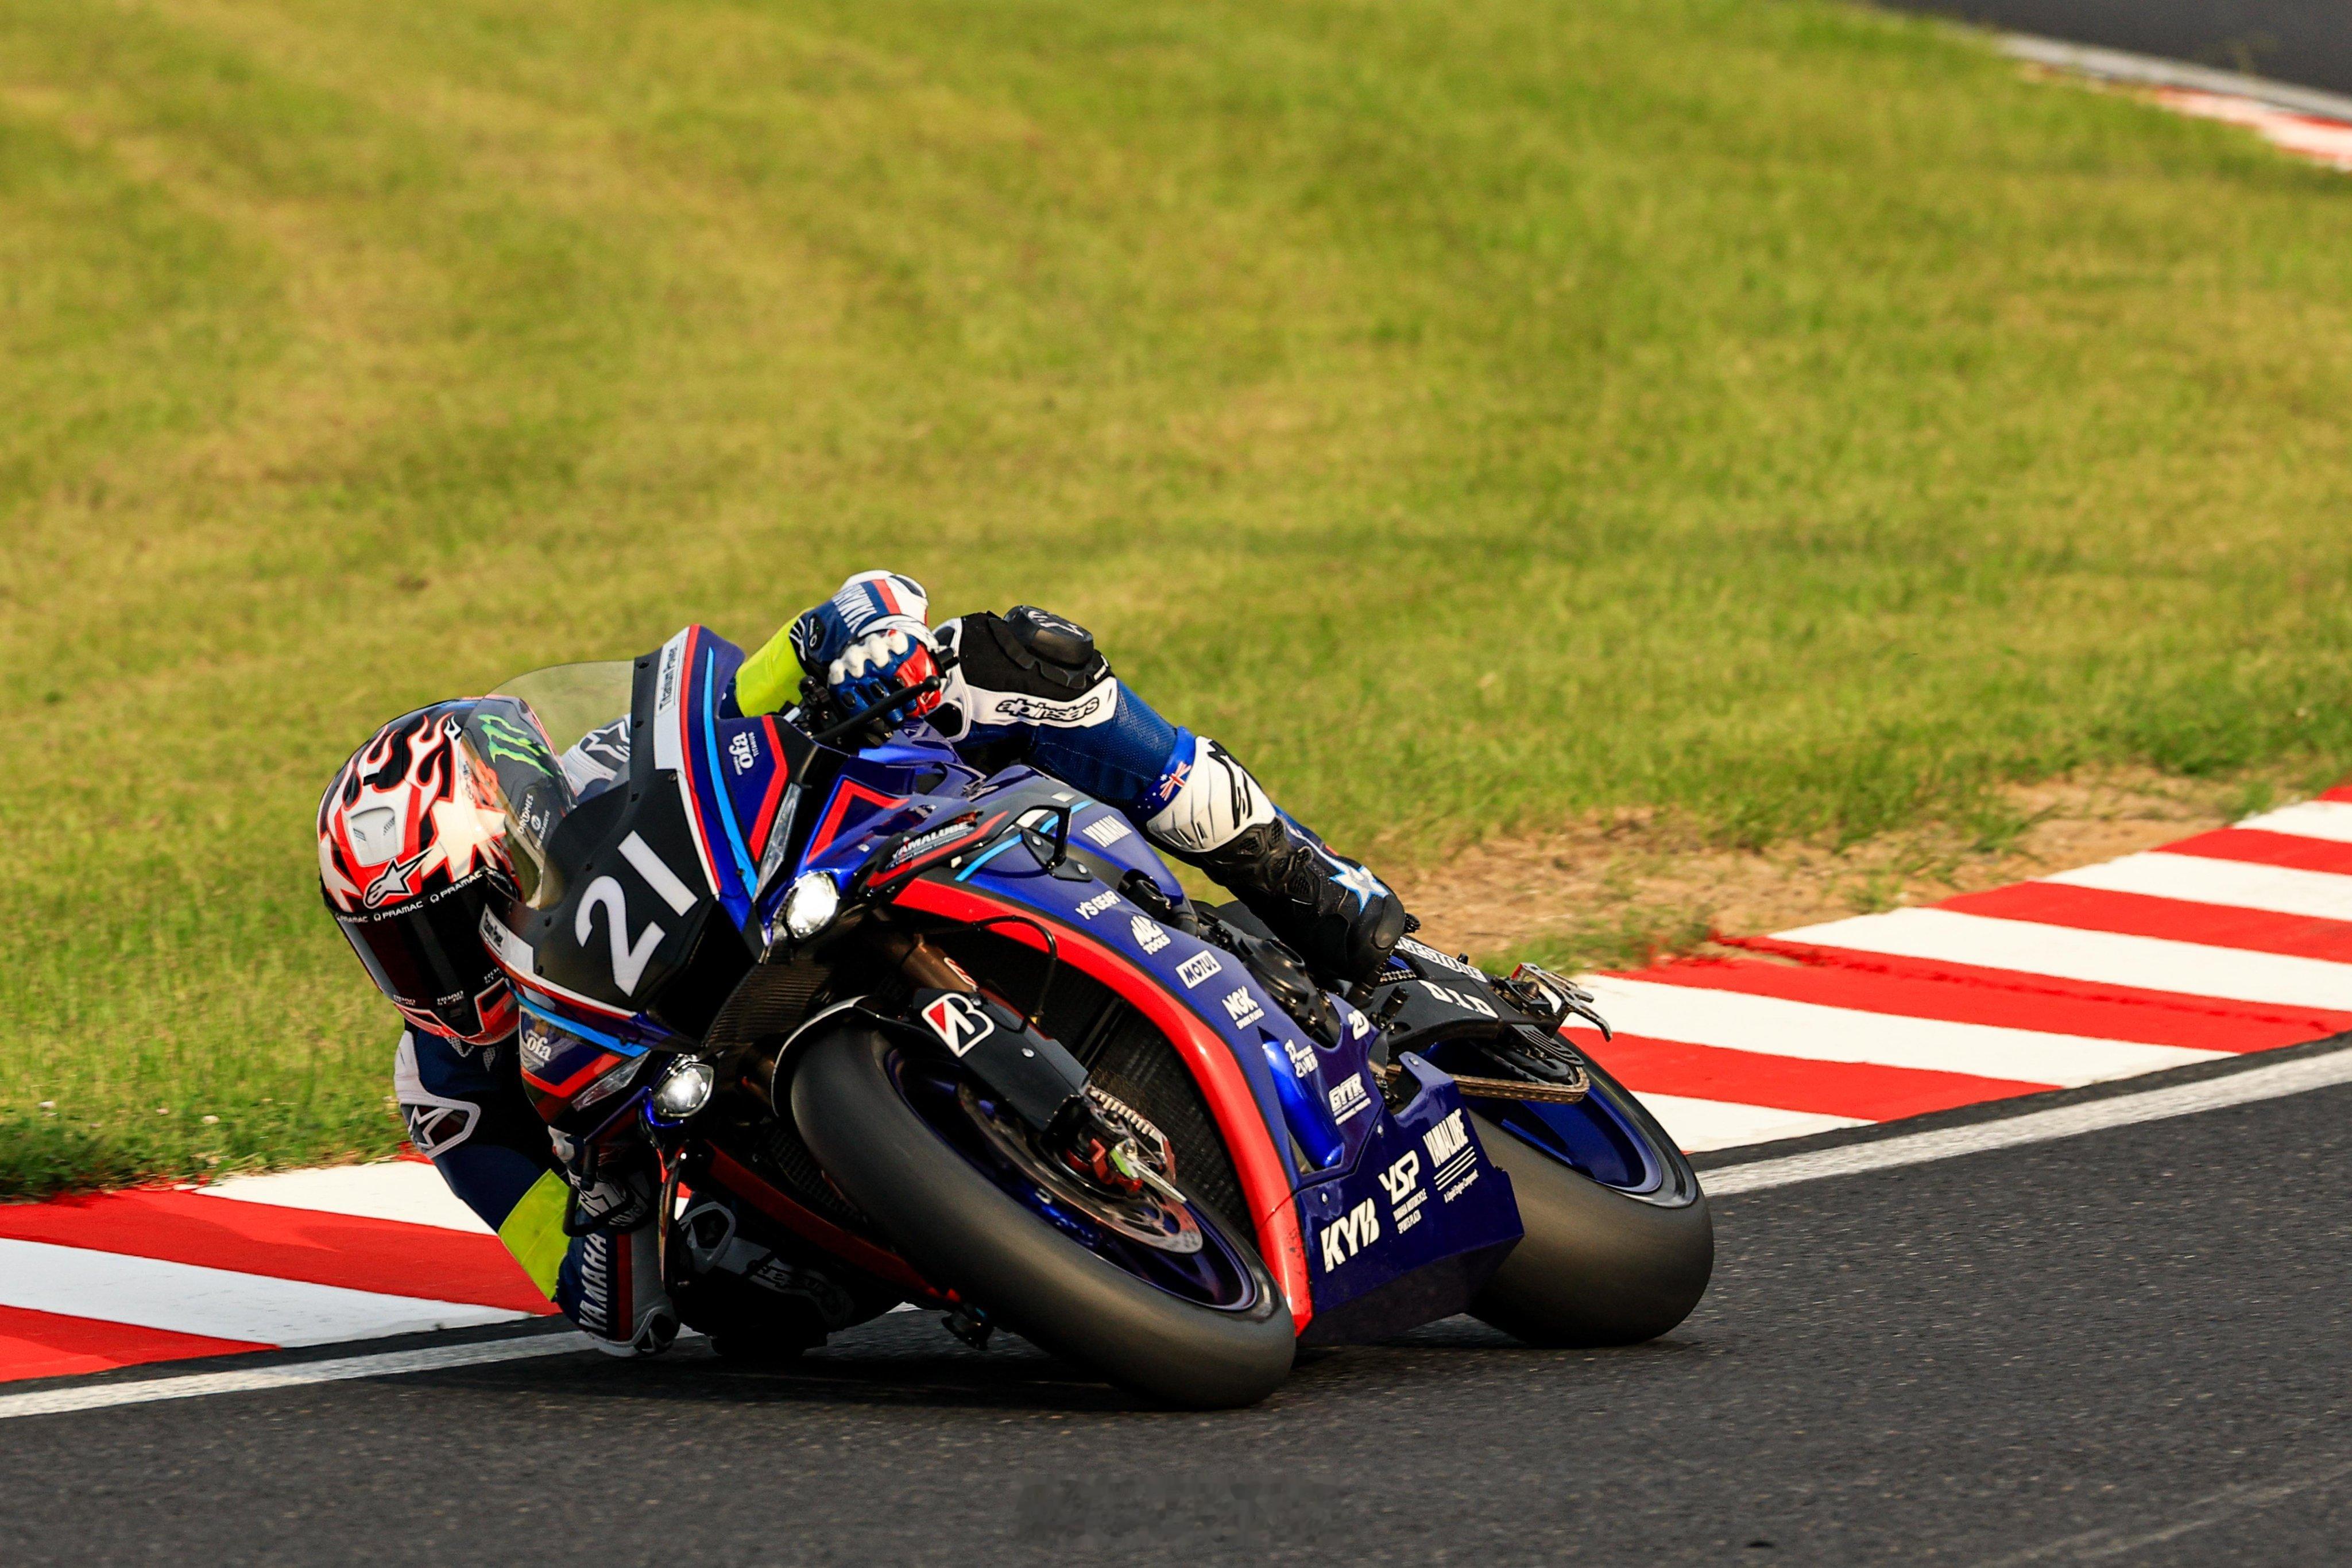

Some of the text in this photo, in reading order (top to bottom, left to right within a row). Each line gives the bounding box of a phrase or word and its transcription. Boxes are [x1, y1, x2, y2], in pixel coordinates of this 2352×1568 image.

[996, 697, 1099, 722] alpinestars
[892, 821, 969, 859] YAMALUBE
[440, 871, 483, 899] PRAMAC
[382, 902, 424, 920] PRAMAC
[575, 830, 698, 996] 21
[1142, 934, 1171, 955] TOOLS
[1395, 936, 1488, 983] GESTONE
[1183, 955, 1217, 984] MOTUL
[1221, 985, 1259, 1021] NGK
[1328, 1072, 1365, 1113] GYTR
[1422, 1108, 1469, 1168] YAMALUBE
[1378, 1150, 1420, 1205] YSP
[1320, 1197, 1380, 1273] KYB
[579, 1233, 608, 1331] YAMAHA
